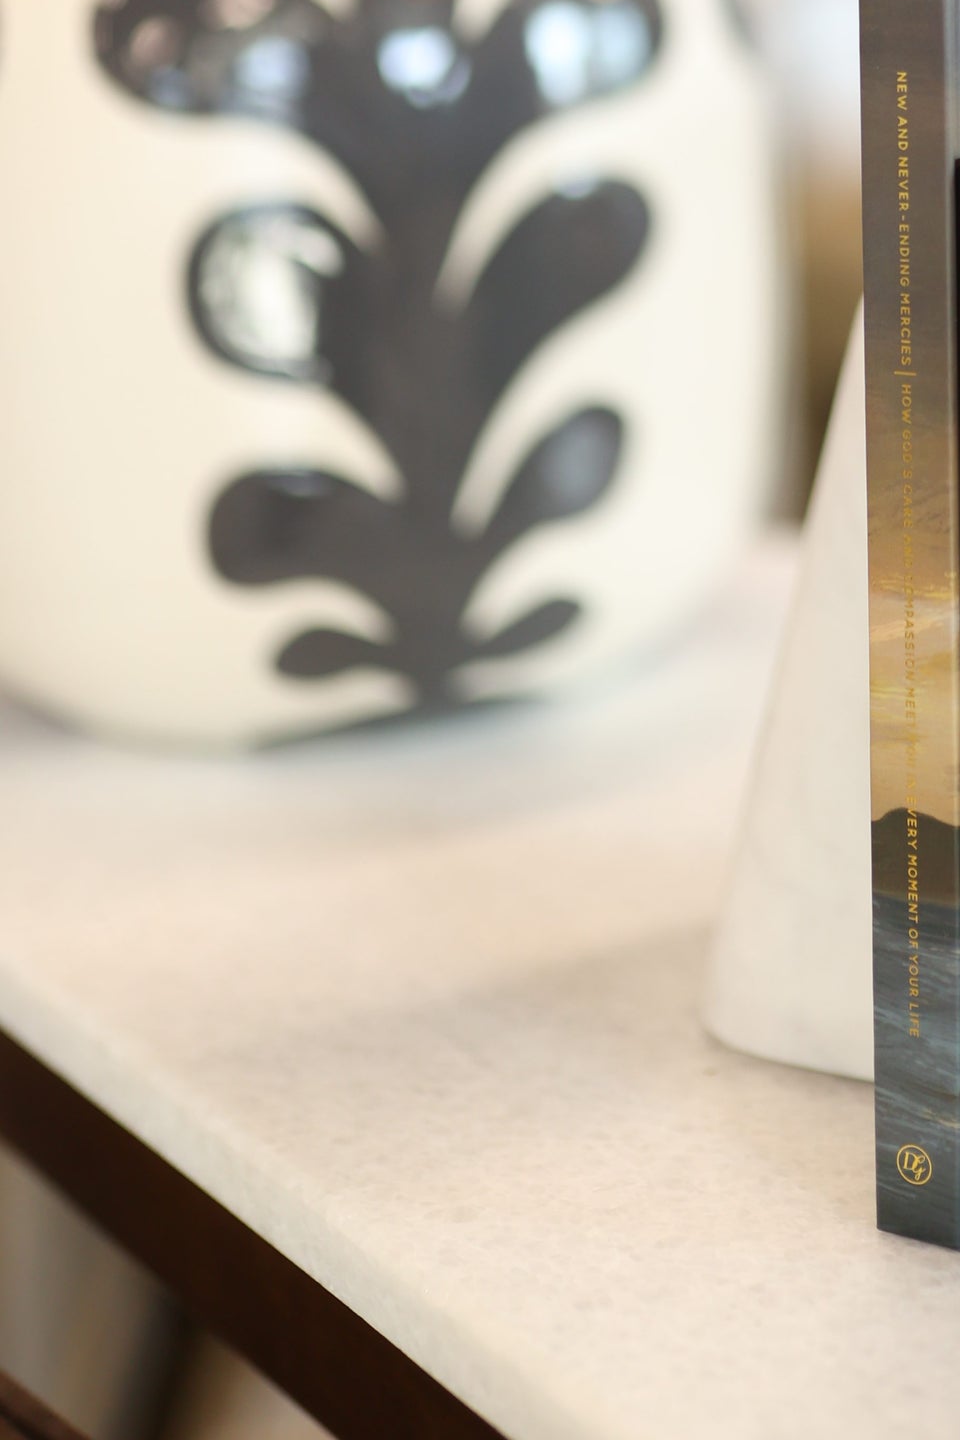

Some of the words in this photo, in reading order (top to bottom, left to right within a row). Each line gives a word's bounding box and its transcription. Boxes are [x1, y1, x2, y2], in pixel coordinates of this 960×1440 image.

[896, 70, 907, 111] NEW
[896, 115, 908, 151] AND
[898, 292, 911, 366] MERCIES
[900, 383, 912, 424] HOW
[900, 428, 912, 479] GOD'S
[901, 484, 913, 528] CARE
[904, 687, 916, 728] MEET
[905, 796, 918, 850] EVERY
[906, 854, 919, 924] MOMENT
[907, 927, 919, 949] OF
[907, 955, 919, 997] YOUR
[908, 1003, 920, 1039] LIFE
